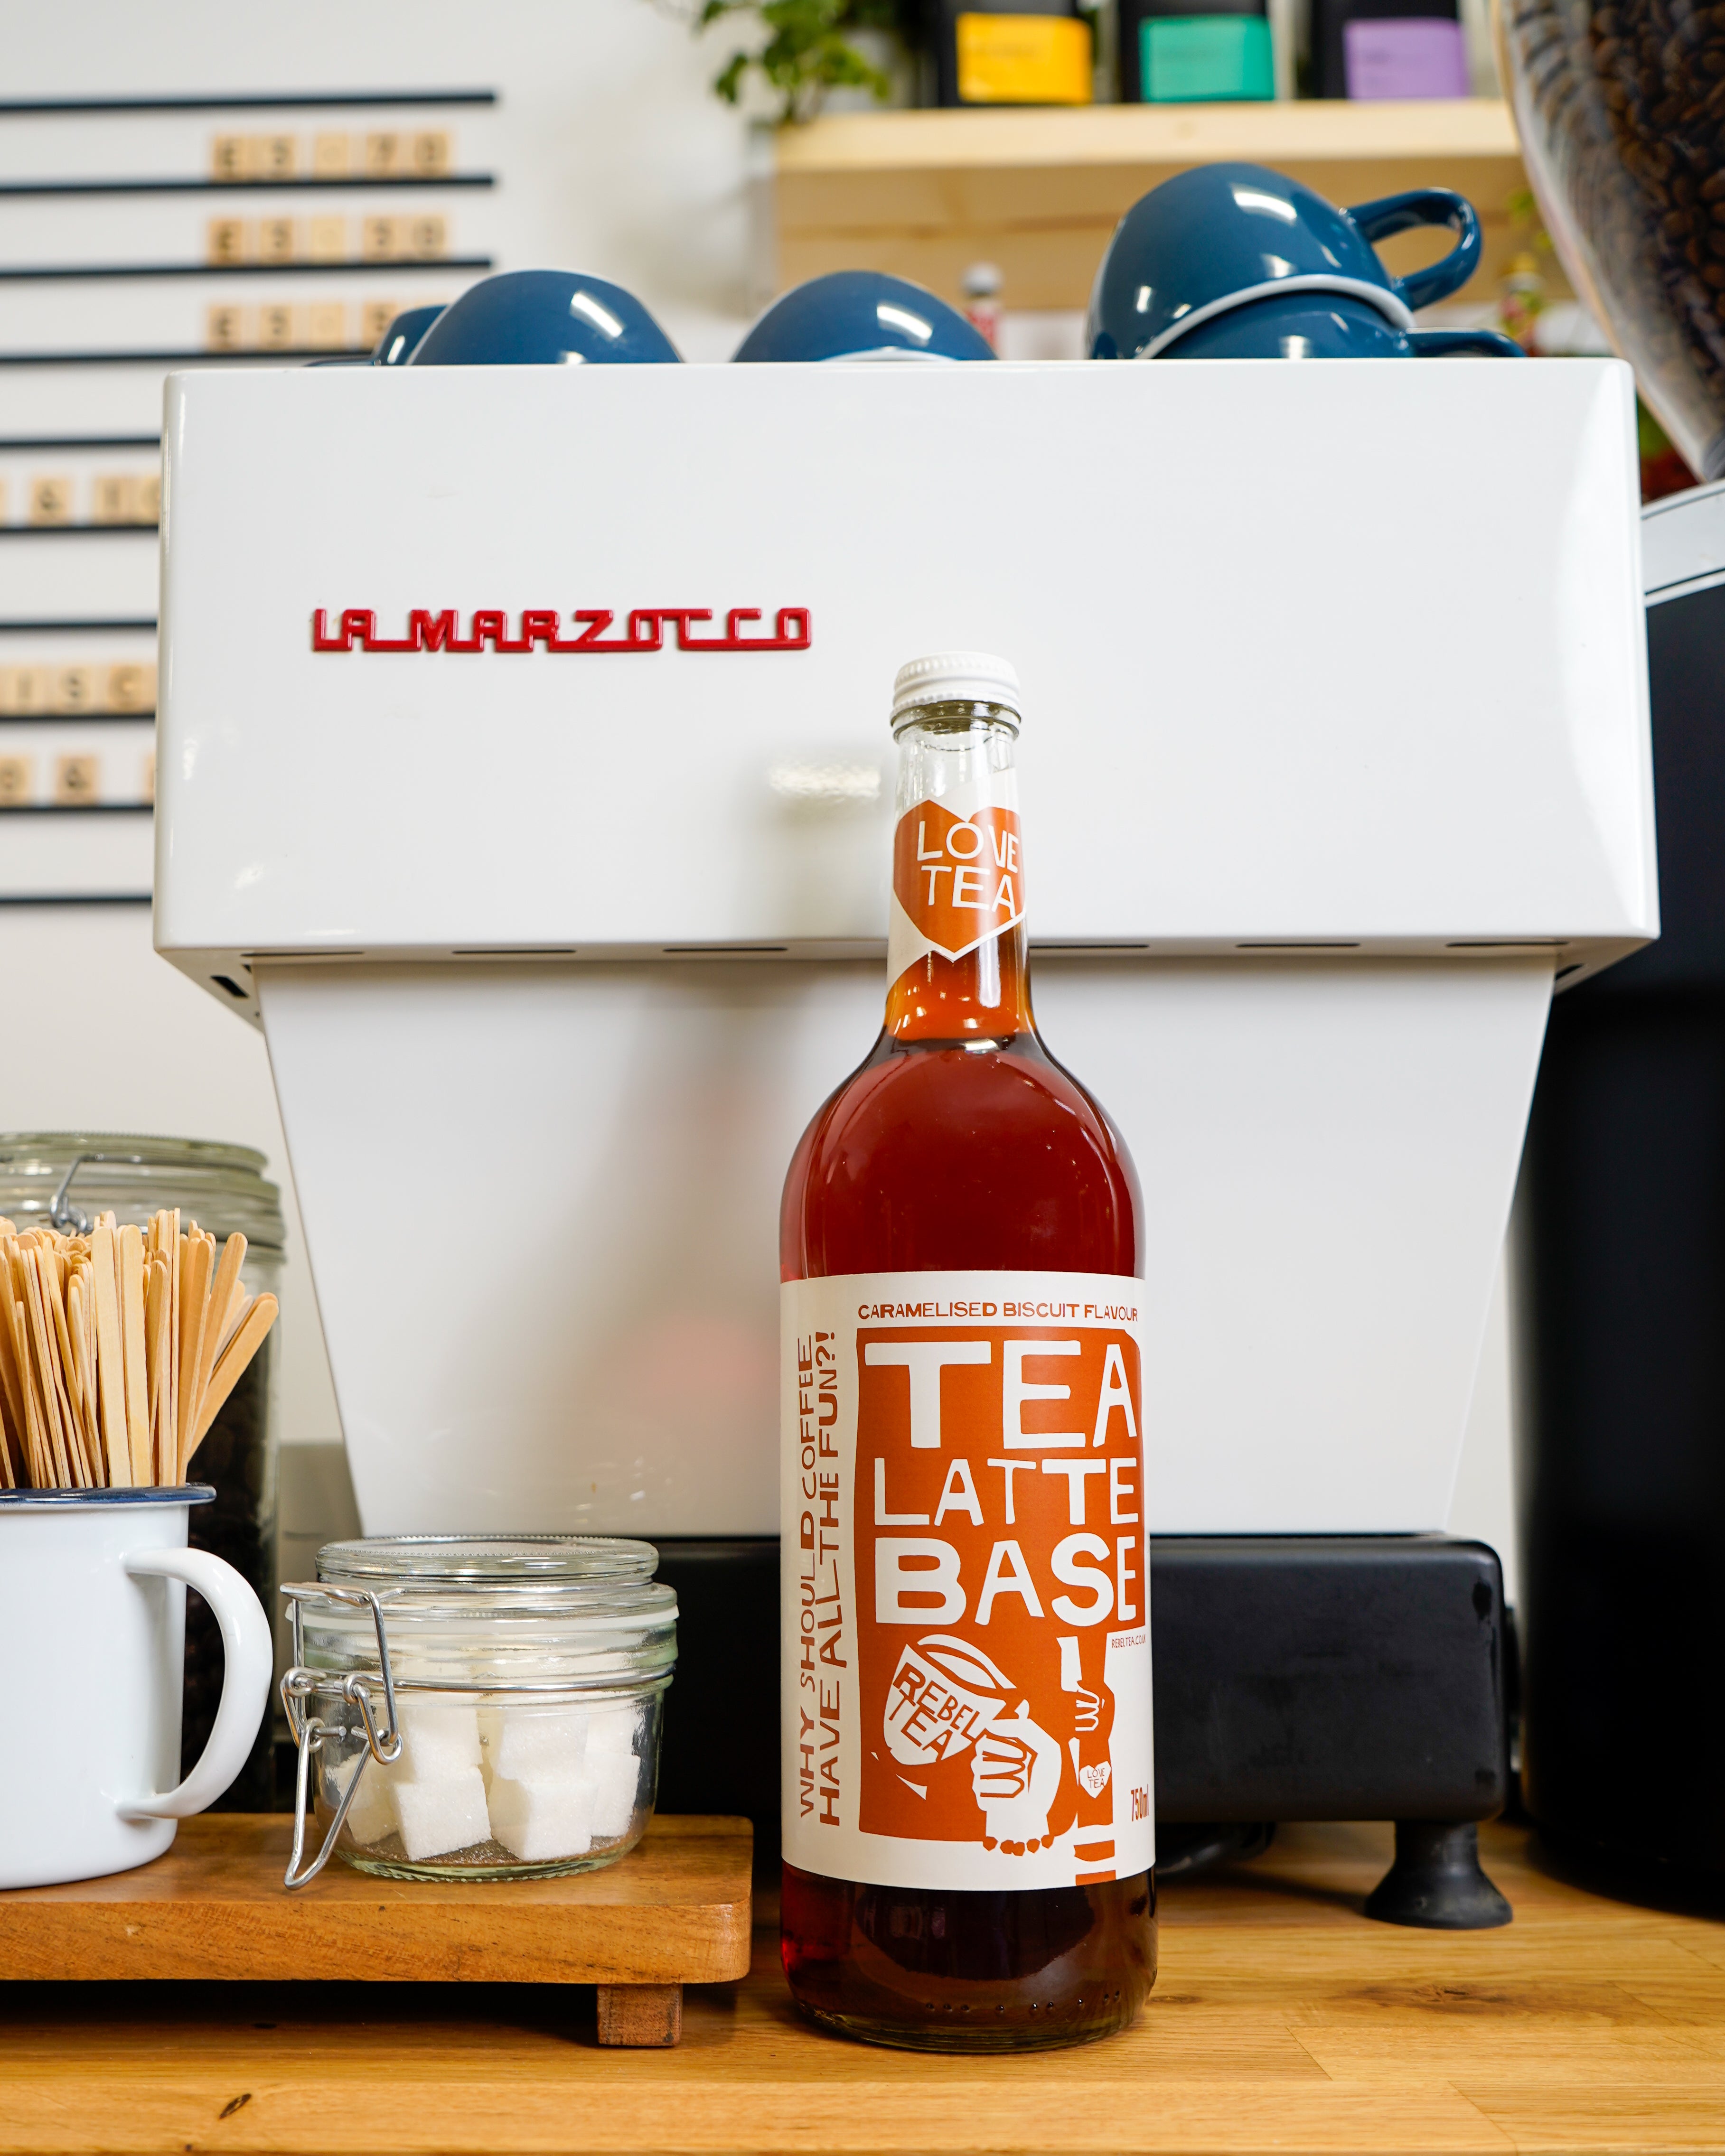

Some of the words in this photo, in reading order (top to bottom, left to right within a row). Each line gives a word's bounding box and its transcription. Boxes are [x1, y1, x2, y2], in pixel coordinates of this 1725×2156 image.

[313, 608, 375, 652] LA
[917, 821, 1019, 874] LOVE
[920, 865, 1017, 919] TEA
[858, 1302, 997, 1319] CARAMELISED
[1003, 1302, 1079, 1318] BISCUIT
[1084, 1304, 1138, 1322] FLAVOUR
[797, 1335, 816, 1500] COFFEE
[816, 1331, 838, 1458] FUN?!
[865, 1340, 1137, 1449] TEA
[819, 1473, 839, 1565] THE
[874, 1457, 1138, 1526] LATTE
[800, 1510, 816, 1692] SHOULD
[815, 1559, 847, 1668] ALL
[875, 1532, 1136, 1627] BASE
[889, 1689, 953, 1762] TEA
[892, 1662, 984, 1744] REBEL
[800, 1705, 815, 1818] WHY
[820, 1679, 840, 1827] HAVE
[1087, 1768, 1105, 1778] LOVE
[1088, 1778, 1105, 1789] TEA
[1131, 1783, 1149, 1822] 750ml
